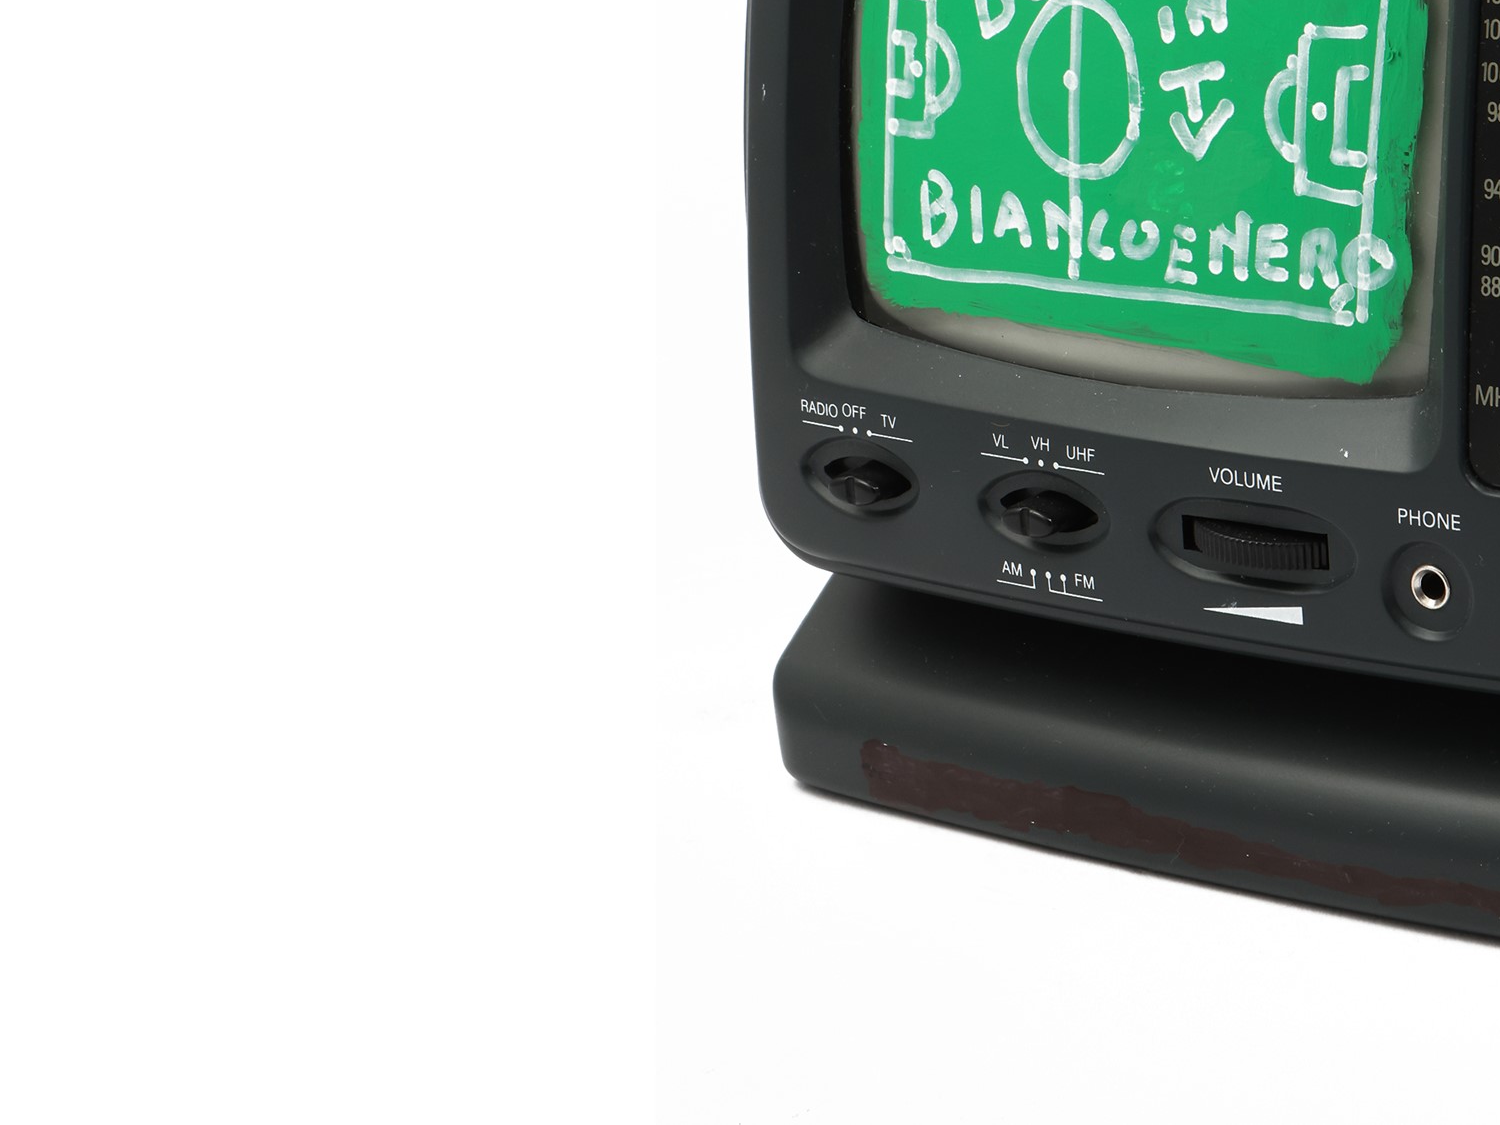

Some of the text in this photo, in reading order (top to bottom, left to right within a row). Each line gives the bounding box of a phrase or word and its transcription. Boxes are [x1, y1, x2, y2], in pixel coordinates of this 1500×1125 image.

[800, 398, 897, 429] RADIO OFF TV
[992, 432, 1096, 462] VL VH UHF
[1208, 466, 1283, 493] VOLUME
[1397, 507, 1461, 532] PHONE
[1002, 560, 1095, 590] AM FM
